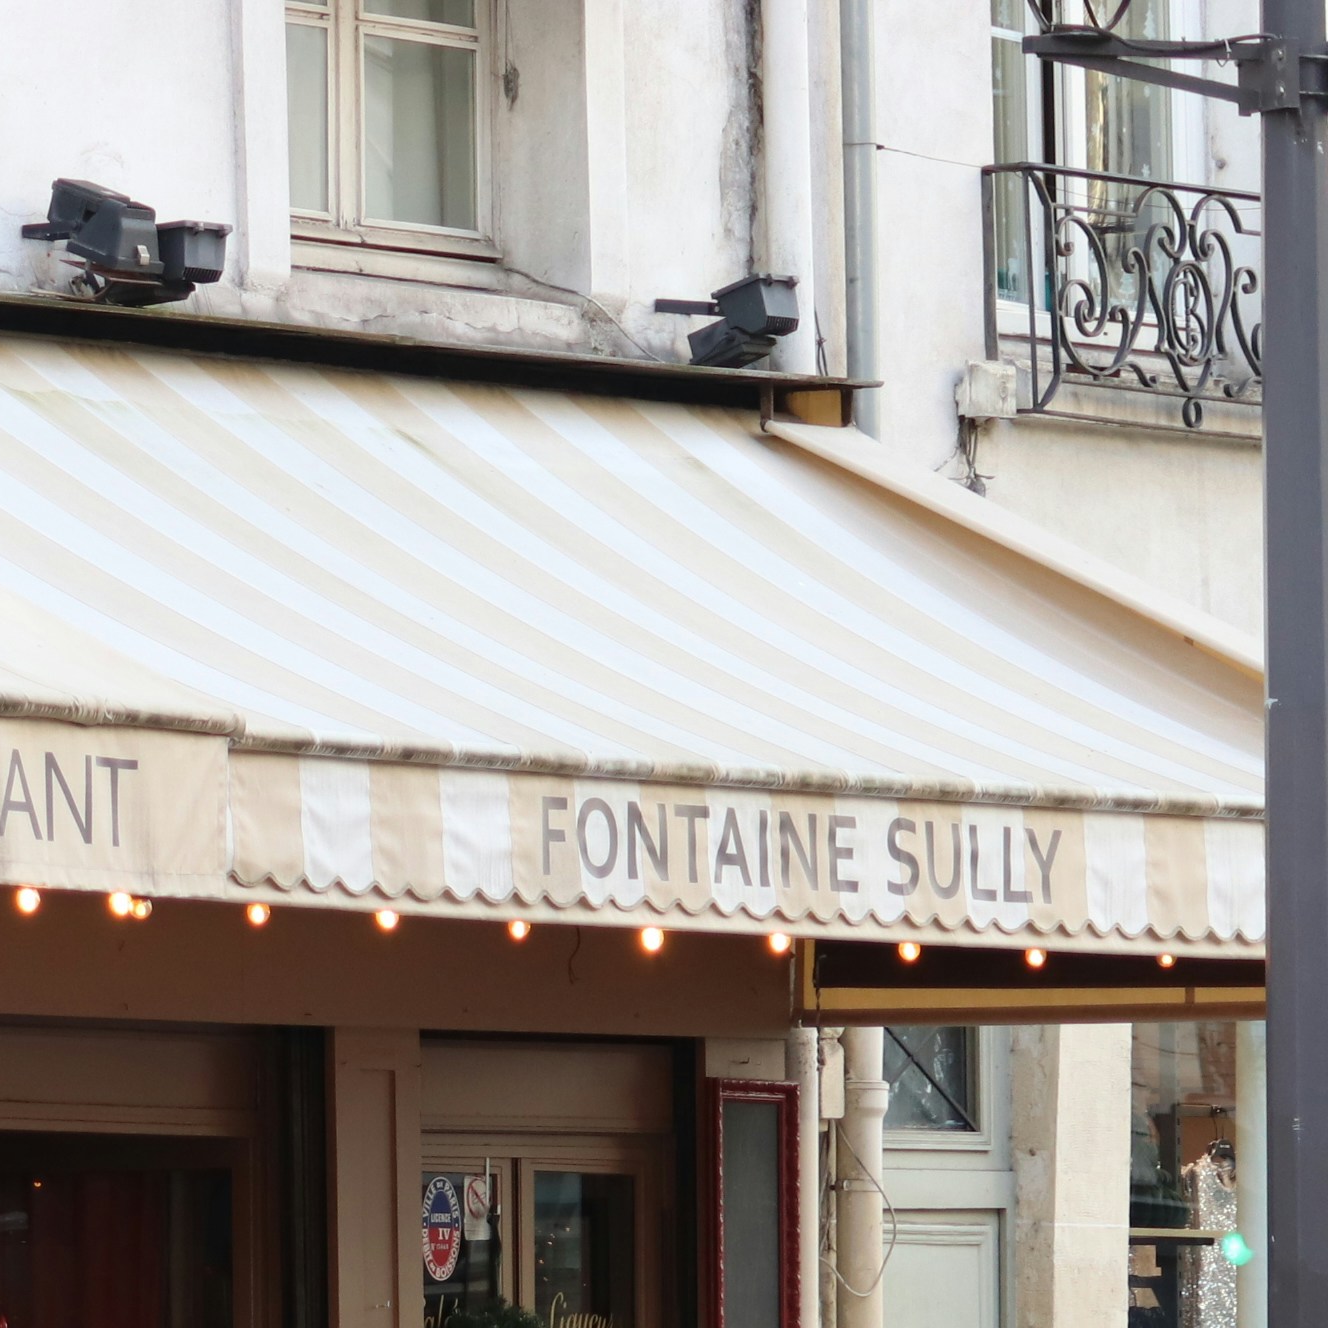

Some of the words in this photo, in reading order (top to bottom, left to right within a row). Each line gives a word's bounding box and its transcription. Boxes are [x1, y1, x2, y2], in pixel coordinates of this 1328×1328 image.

[541, 796, 861, 894] FONTAINE
[884, 816, 1064, 905] SULLY
[423, 1183, 436, 1218] VILLE
[444, 1182, 460, 1219] PARIS
[438, 1226, 451, 1240] IV
